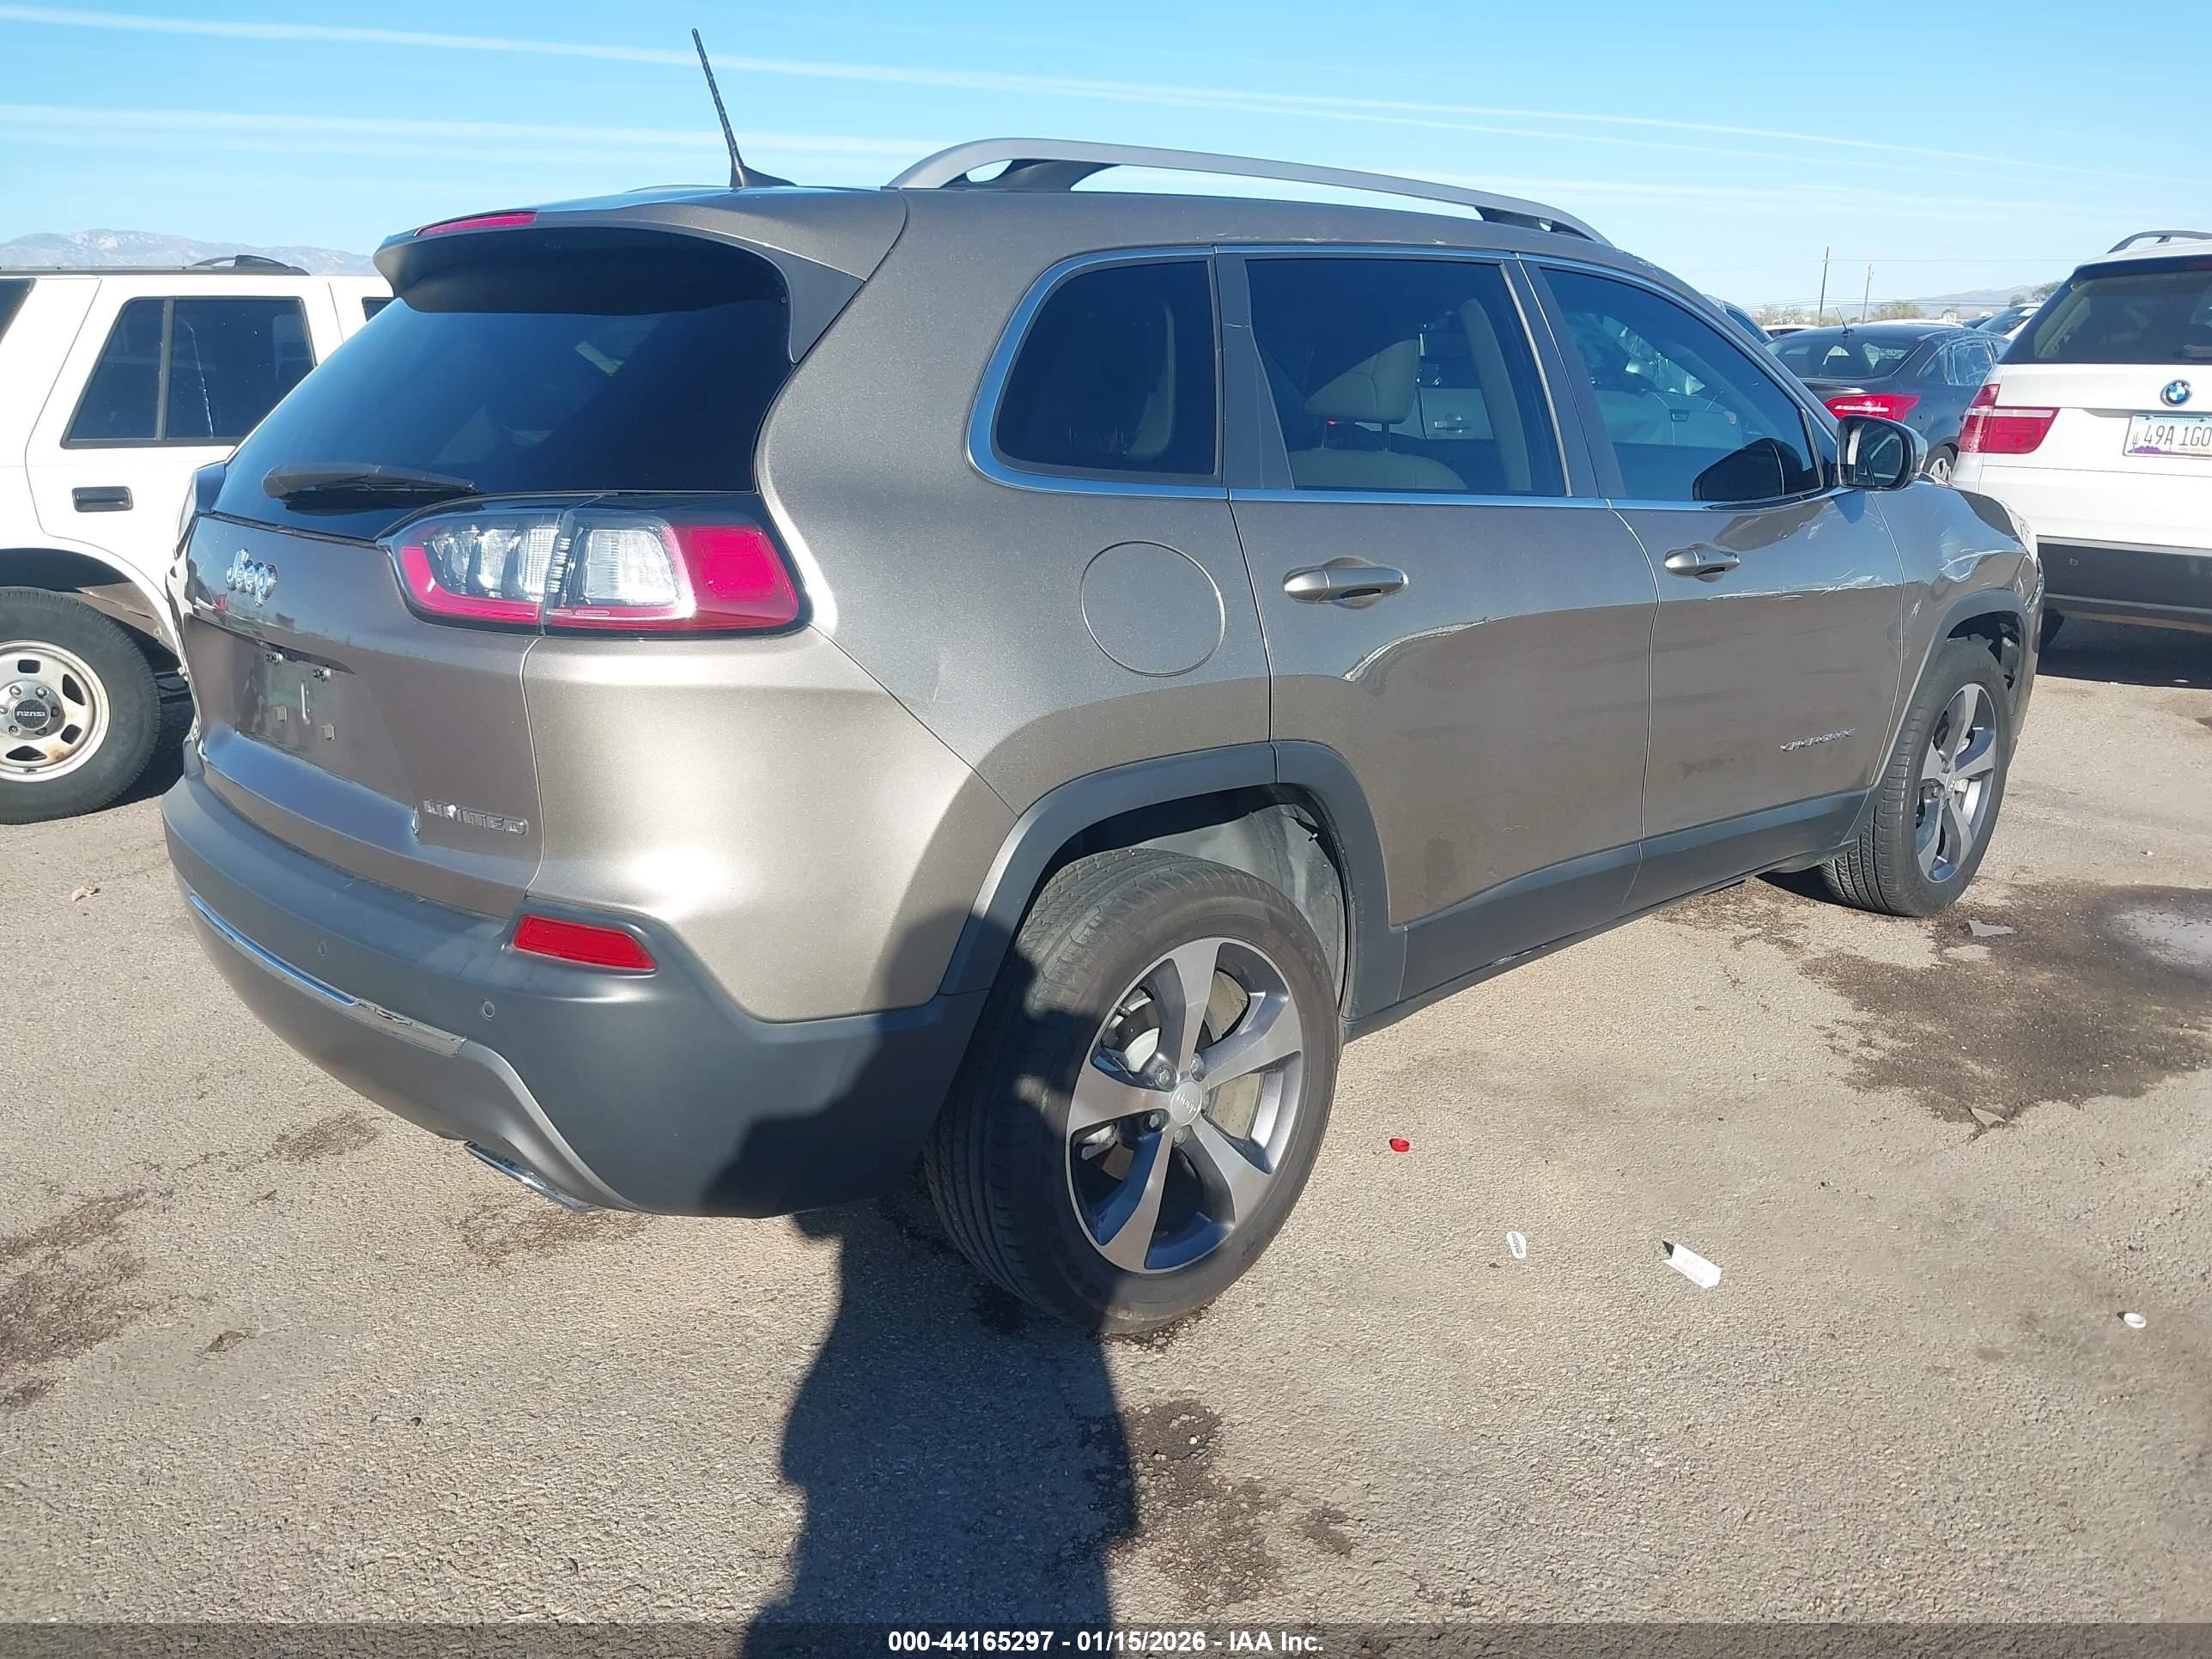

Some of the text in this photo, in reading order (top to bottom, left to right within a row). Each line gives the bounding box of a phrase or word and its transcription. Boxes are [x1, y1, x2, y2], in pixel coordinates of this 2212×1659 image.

[2144, 424, 2174, 446] 49A
[226, 548, 277, 607] Jeep
[422, 798, 529, 836] LIMITED
